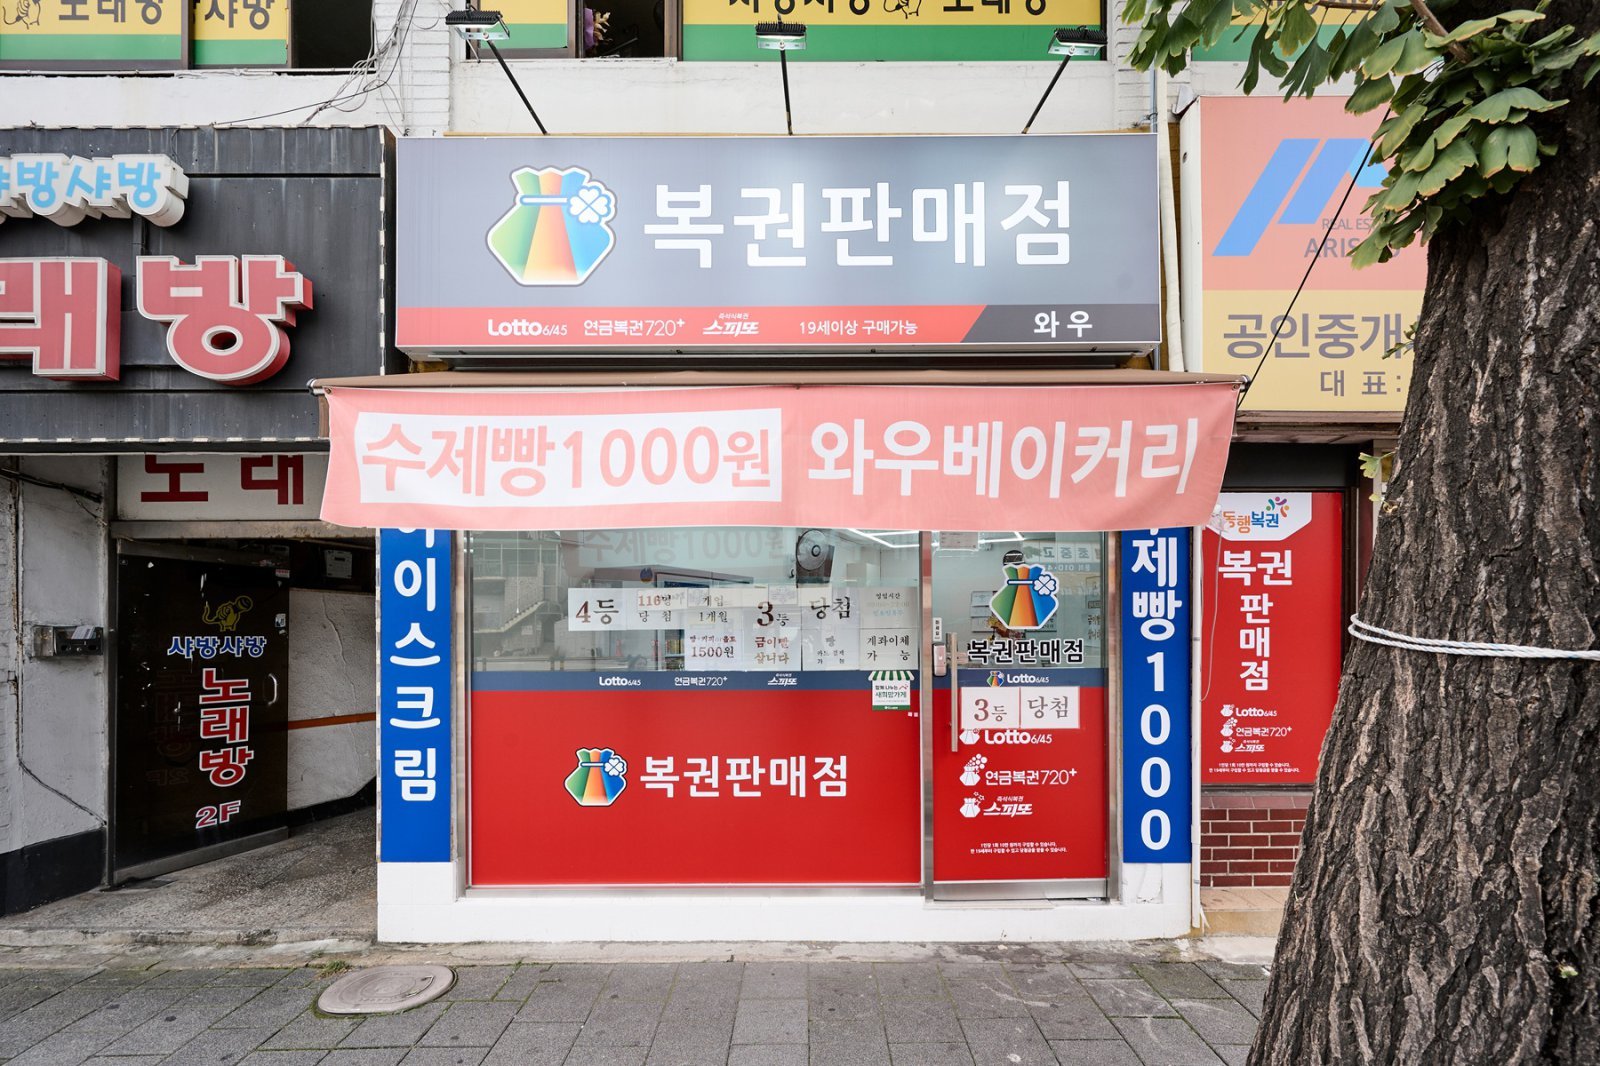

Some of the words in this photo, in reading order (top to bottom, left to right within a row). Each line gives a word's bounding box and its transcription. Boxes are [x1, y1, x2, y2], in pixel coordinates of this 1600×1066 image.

[0, 160, 161, 208] 방샤방
[644, 181, 1071, 268] 복권판매점
[702, 320, 759, 337] 스피또
[799, 320, 858, 335] 19세이상
[862, 320, 918, 335] 구매가능
[1223, 313, 1420, 359] 공인중개
[362, 423, 770, 497] 수제빵1000원
[807, 418, 1198, 498] 와우베이커리
[1219, 550, 1293, 586] 복권
[575, 599, 619, 625] 4등
[757, 601, 789, 627] 3등
[809, 596, 850, 619] 당첨
[167, 636, 267, 659] 샤방샤방
[692, 646, 734, 658] 1500원
[968, 639, 1084, 664] 복권판매점
[390, 528, 441, 801] 이스크림
[1131, 528, 1182, 850] 제빵1000
[974, 698, 1007, 722] 3등
[1028, 696, 1068, 719] 당첨
[199, 667, 254, 787] 노래방
[640, 756, 847, 798] 복권판매점
[195, 800, 241, 829] 2F
[983, 801, 1033, 818] 스피또
